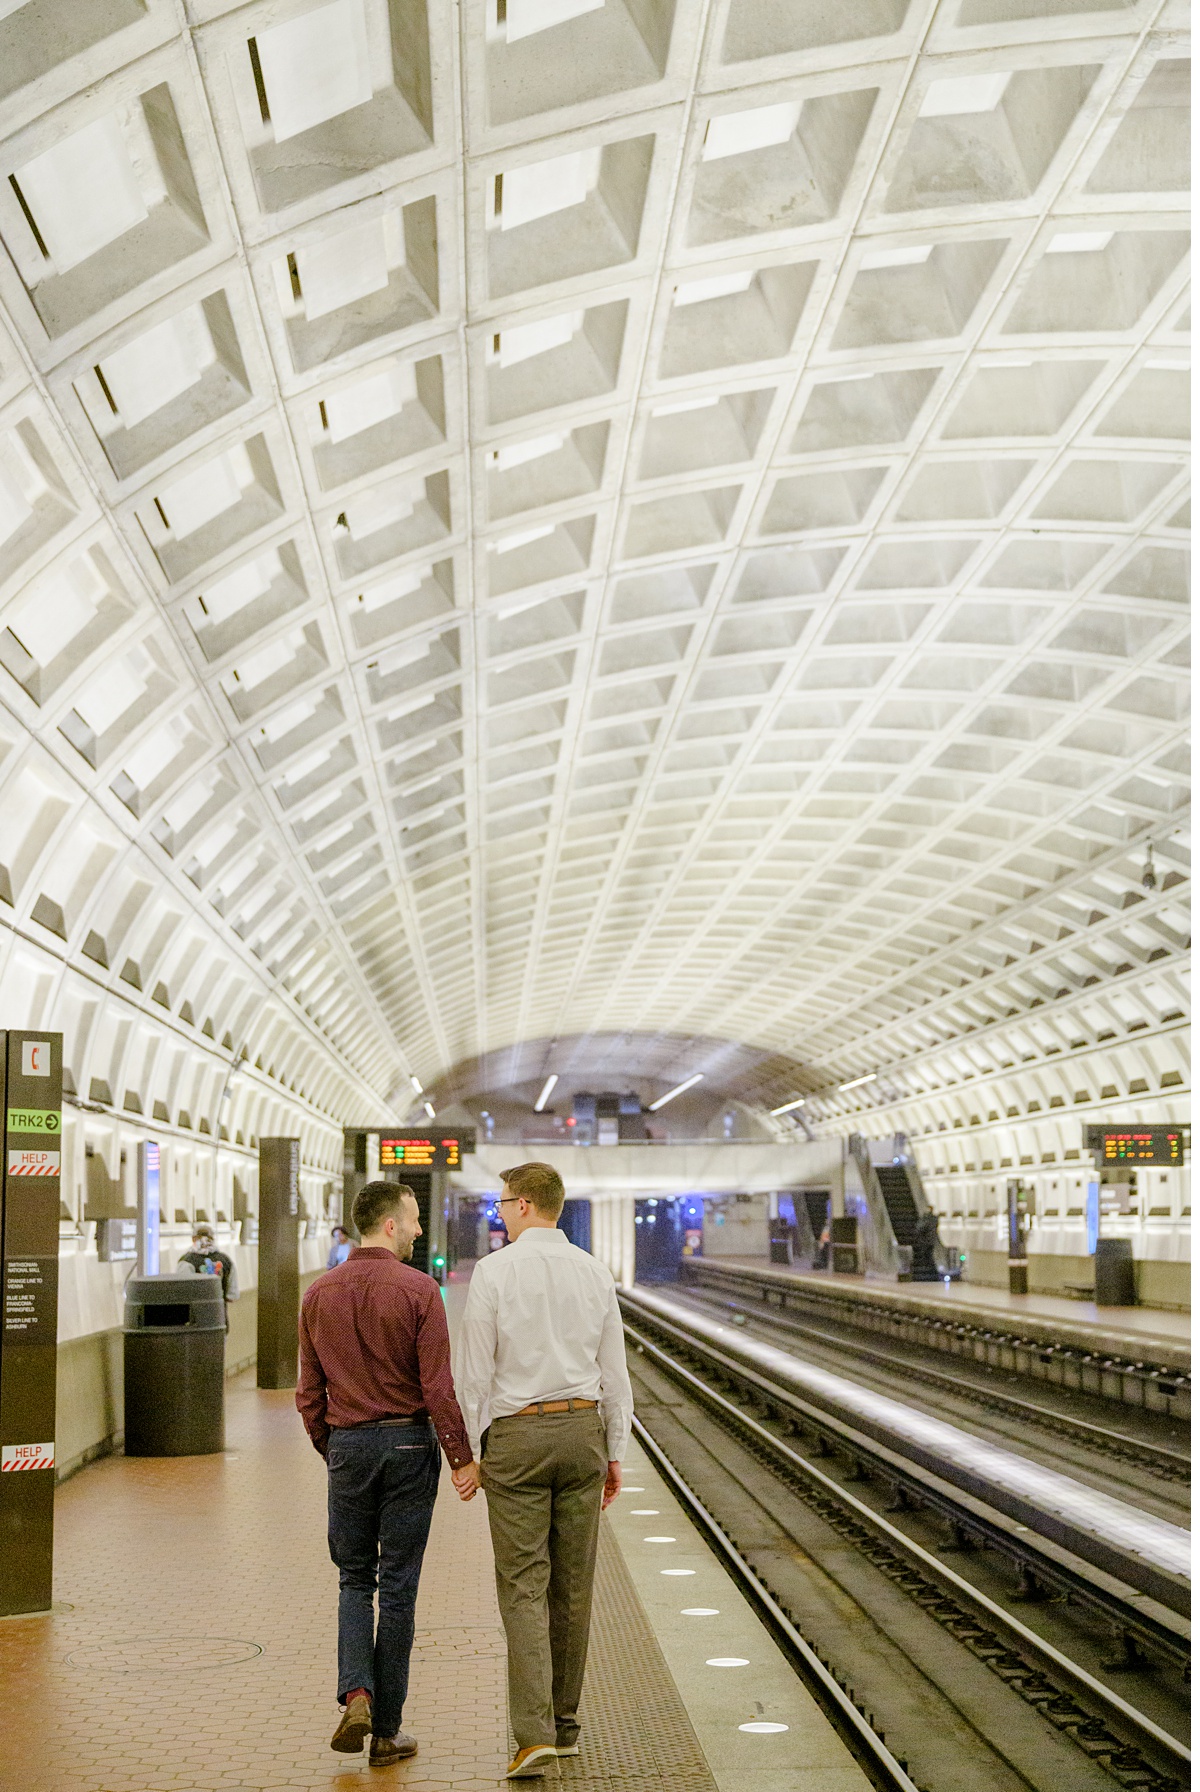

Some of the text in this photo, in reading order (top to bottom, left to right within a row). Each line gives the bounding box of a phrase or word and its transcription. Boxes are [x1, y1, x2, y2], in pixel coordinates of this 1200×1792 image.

[10, 1114, 43, 1127] TRK2
[21, 1153, 48, 1163] HELP
[15, 1446, 42, 1458] HELP
